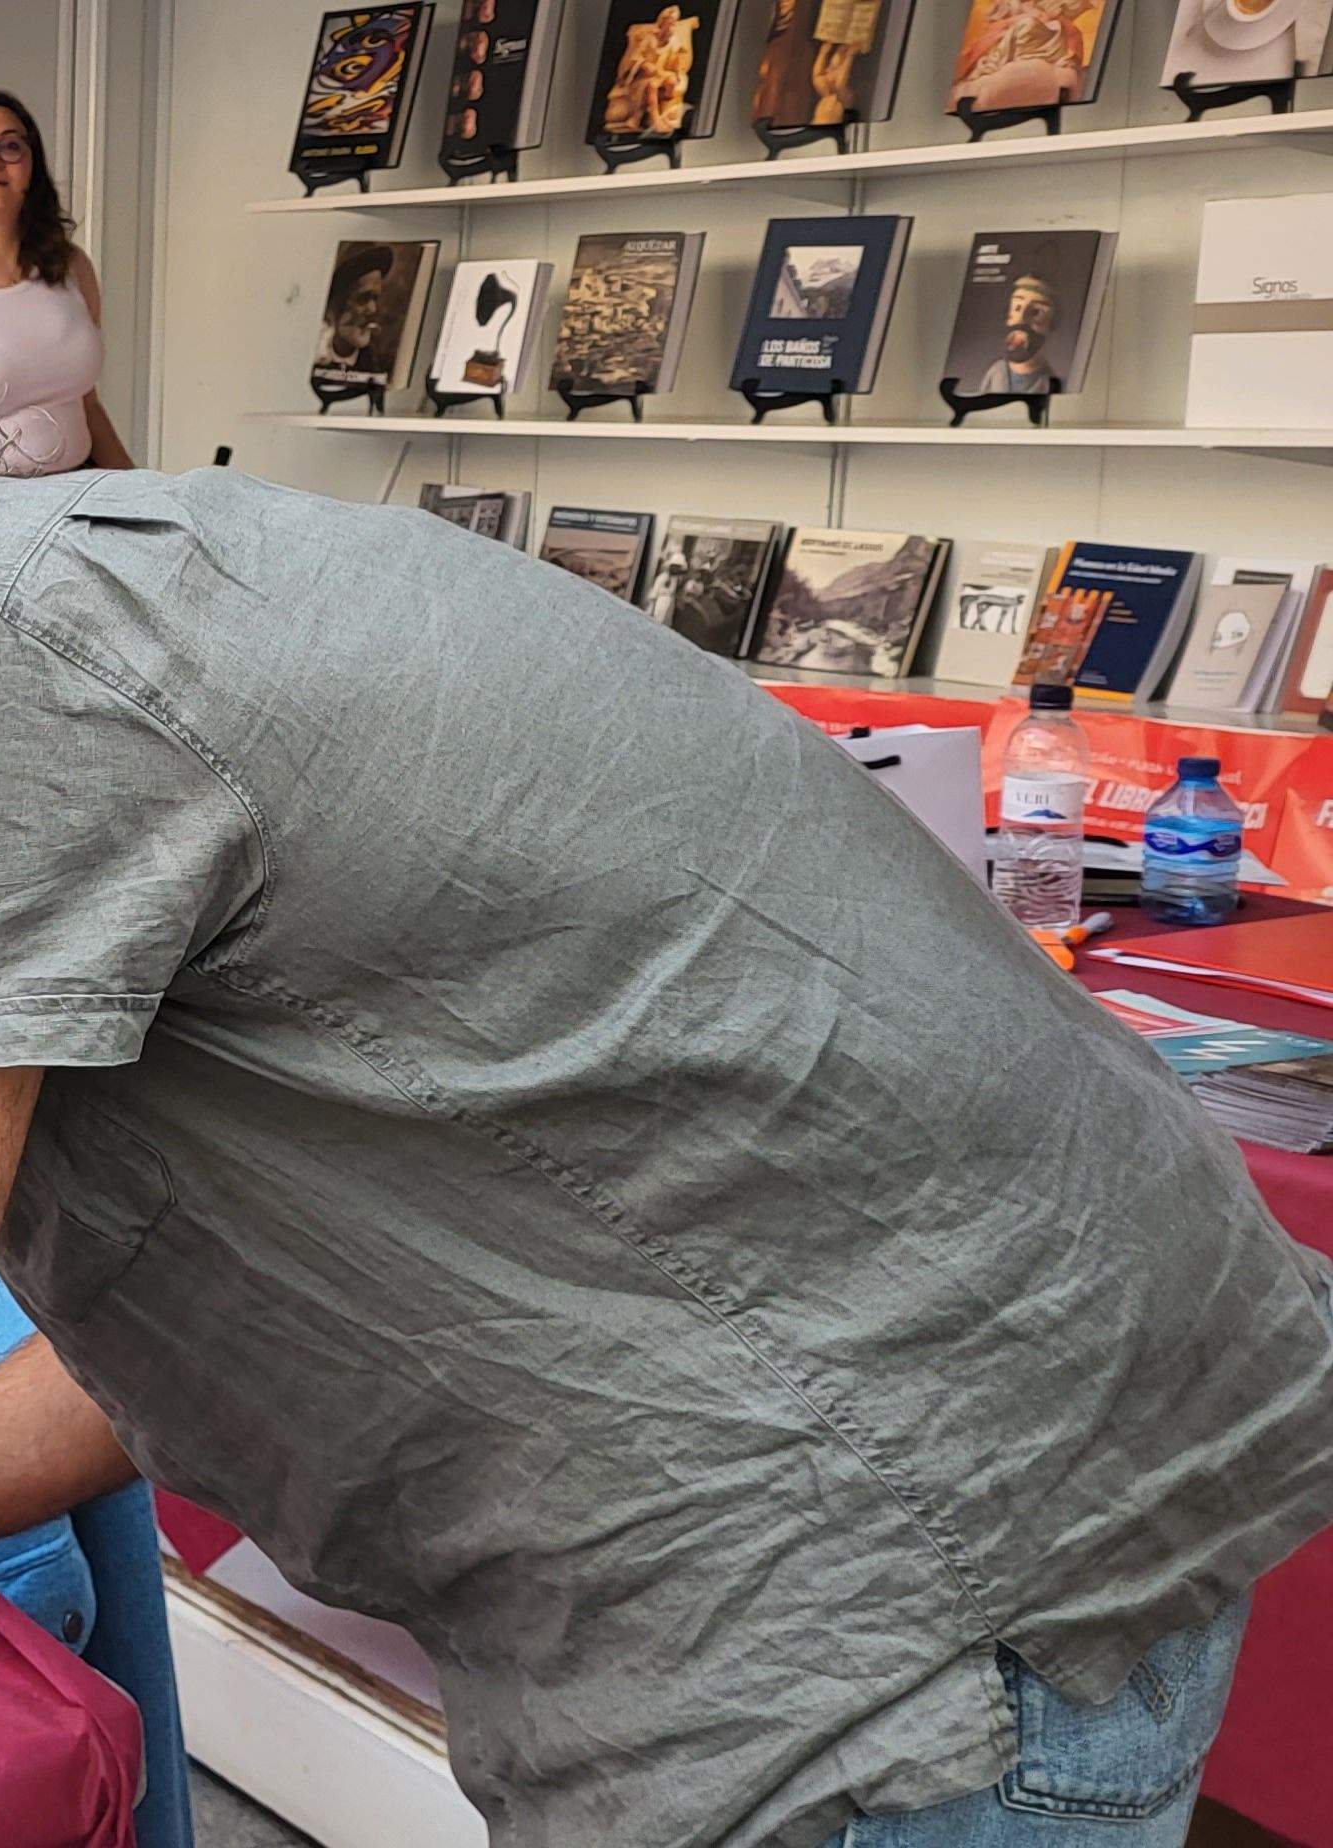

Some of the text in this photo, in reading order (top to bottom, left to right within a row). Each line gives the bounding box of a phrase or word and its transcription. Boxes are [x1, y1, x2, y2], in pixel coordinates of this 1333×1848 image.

[1252, 276, 1299, 299] Signos
[760, 339, 785, 354] LOS
[757, 354, 775, 367] DE
